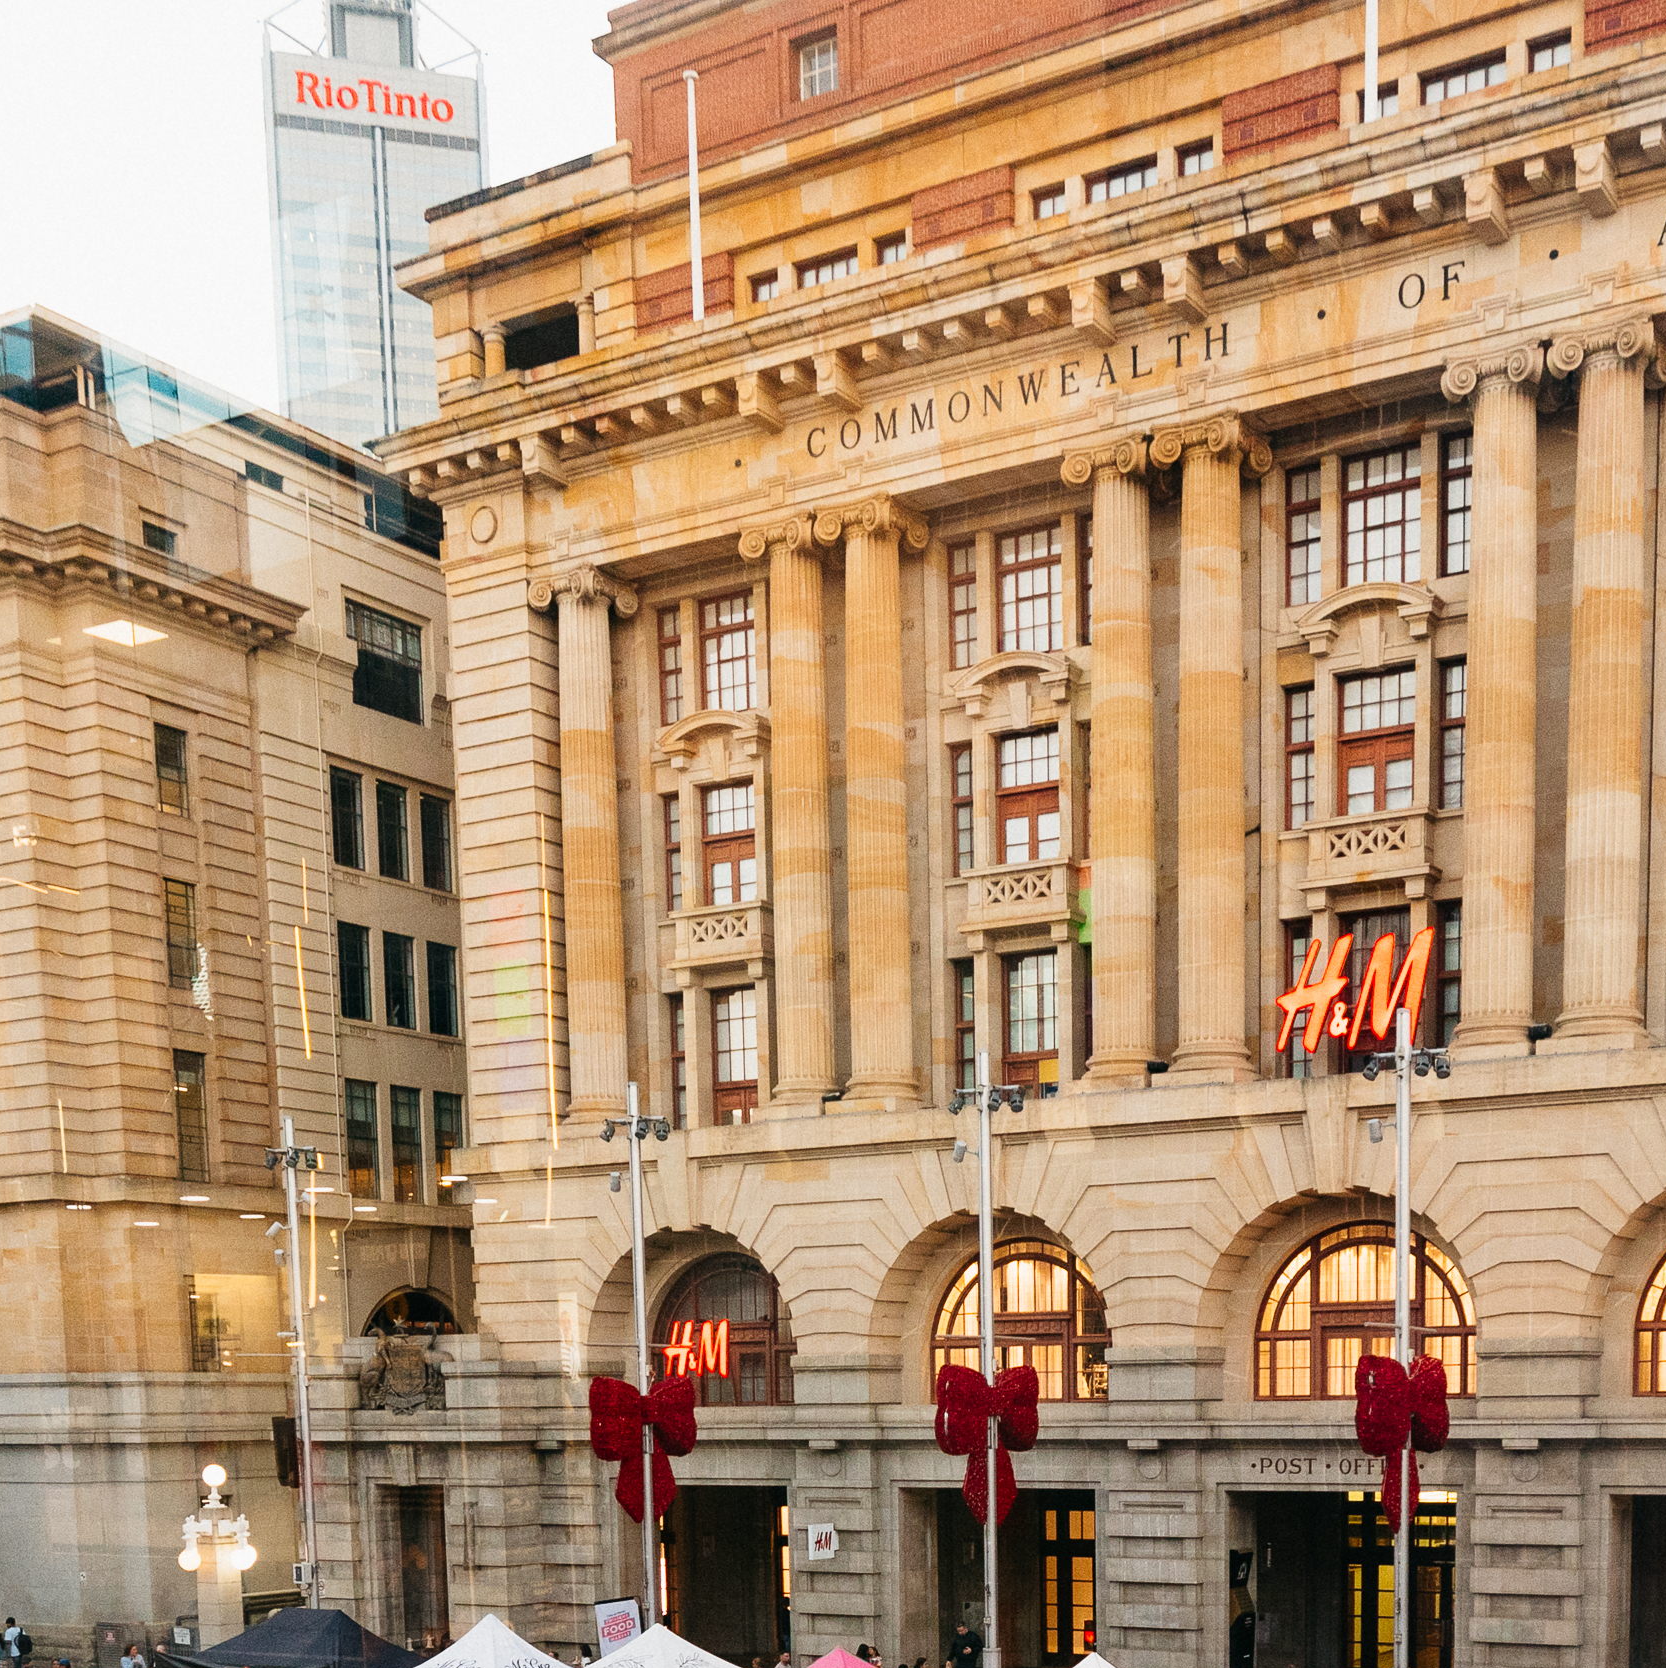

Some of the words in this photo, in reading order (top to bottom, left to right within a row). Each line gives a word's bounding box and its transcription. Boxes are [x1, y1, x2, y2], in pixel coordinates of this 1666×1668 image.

[807, 321, 1231, 459] COMMONWEALTH
[1398, 260, 1466, 309] OF
[1275, 926, 1434, 1053] H&M
[662, 1318, 729, 1378] H&M
[1260, 1457, 1317, 1475] POST
[1339, 1458, 1385, 1475] OFFI
[814, 1531, 832, 1552] H&M
[603, 1619, 634, 1636] FOOD
